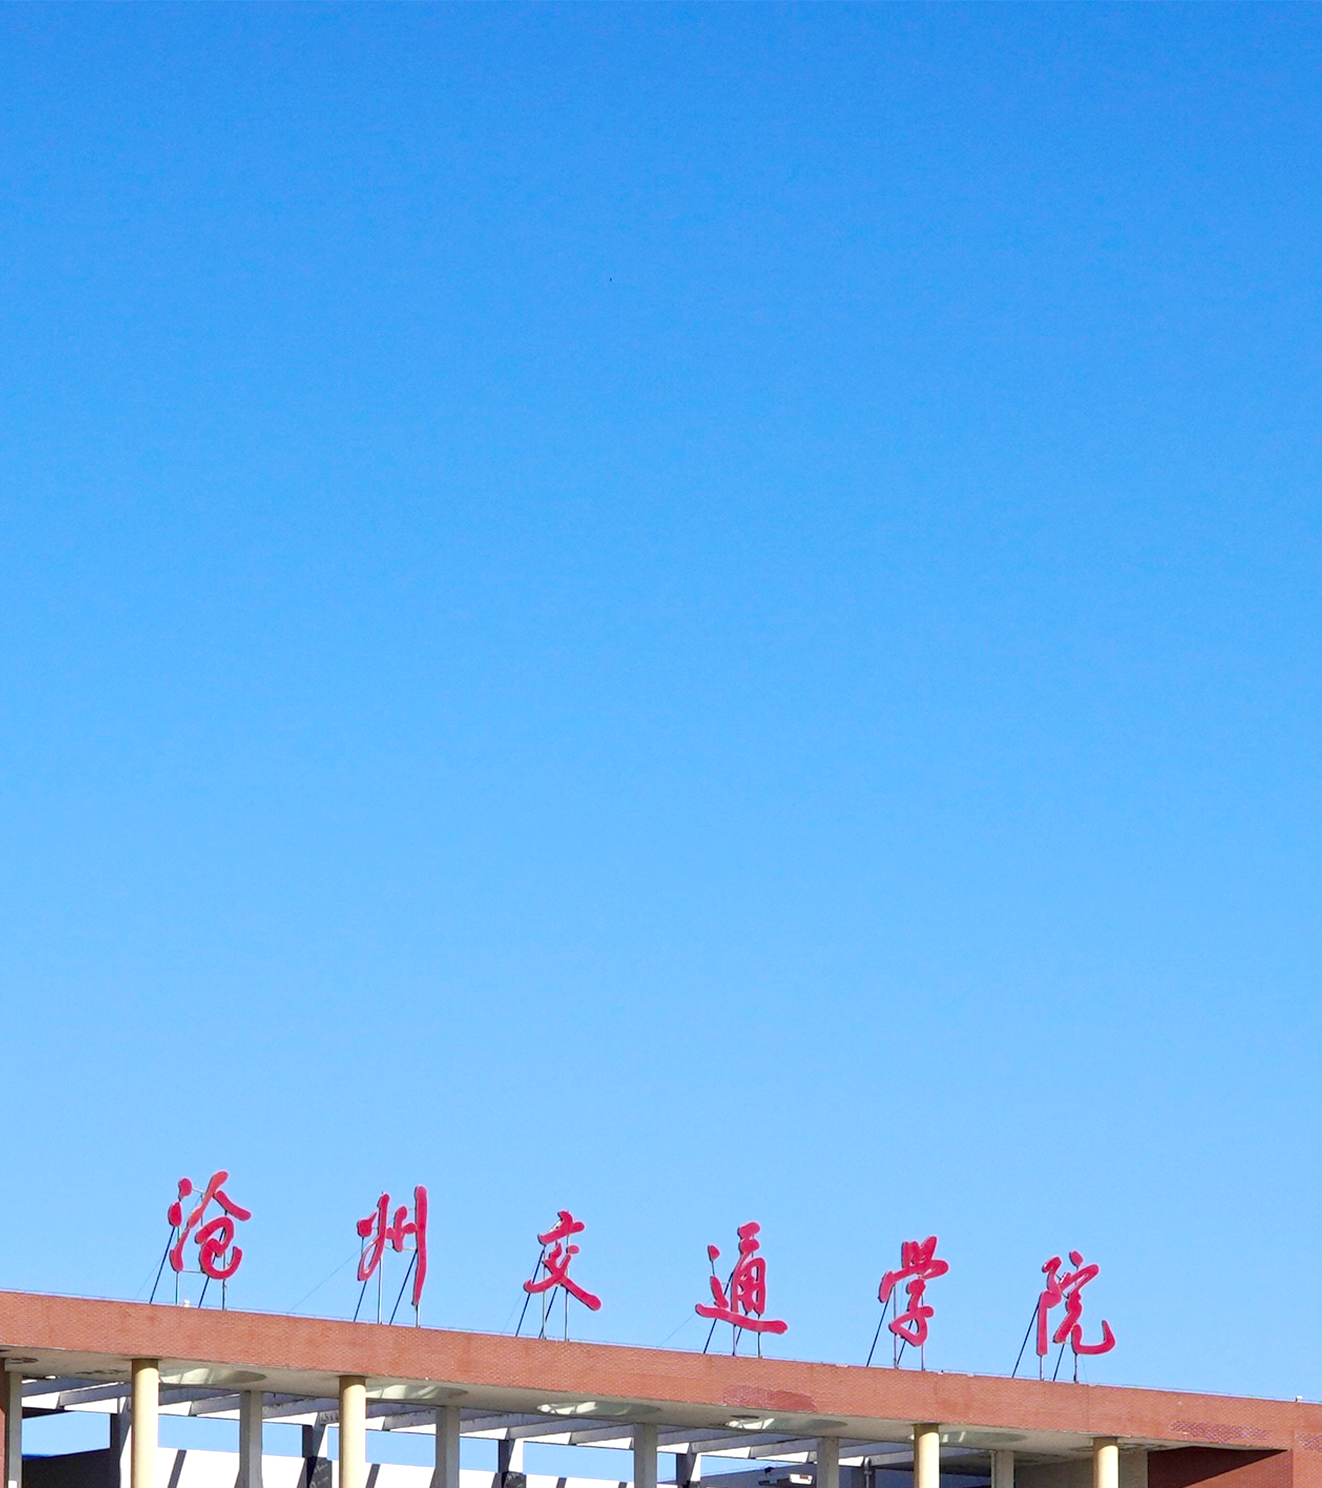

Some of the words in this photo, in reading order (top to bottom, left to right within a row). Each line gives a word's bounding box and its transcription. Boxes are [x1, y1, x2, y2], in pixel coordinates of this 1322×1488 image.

[167, 1171, 1115, 1356] 沧州交通学院
